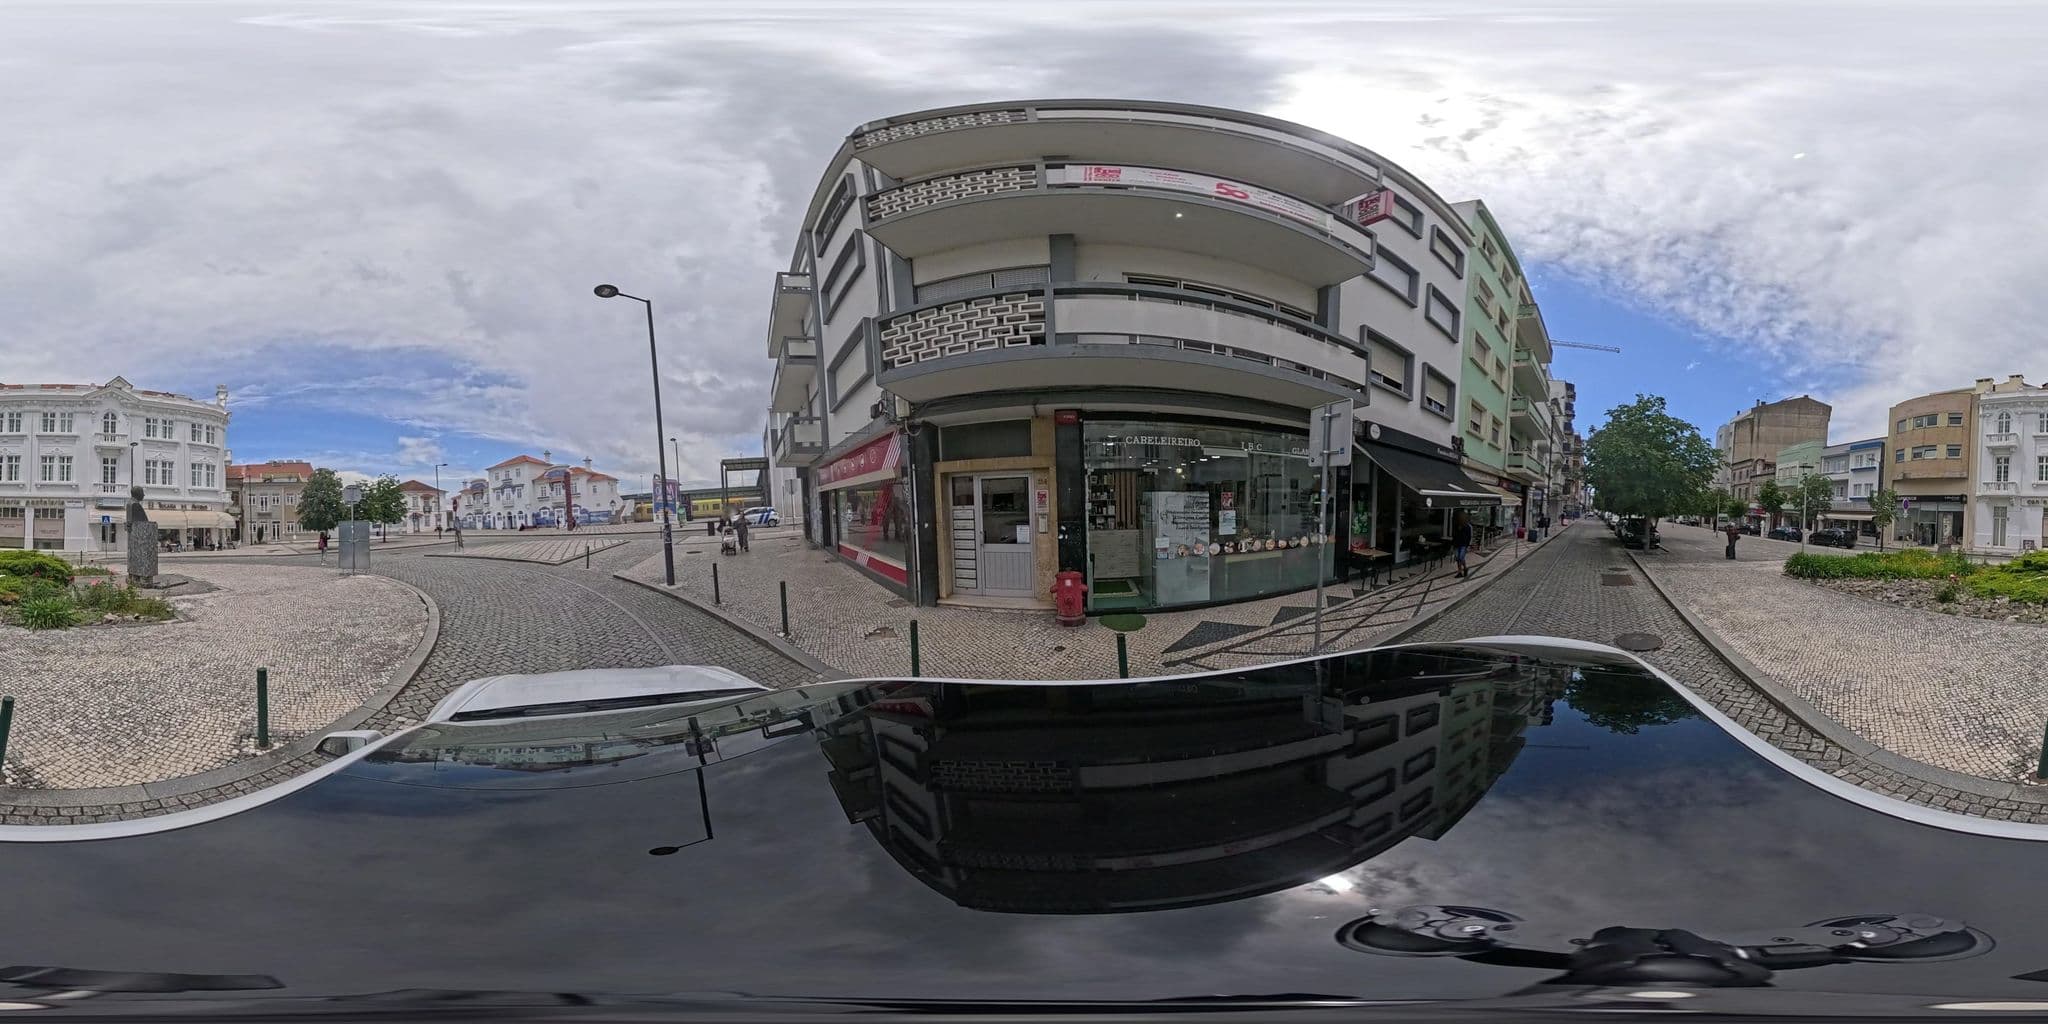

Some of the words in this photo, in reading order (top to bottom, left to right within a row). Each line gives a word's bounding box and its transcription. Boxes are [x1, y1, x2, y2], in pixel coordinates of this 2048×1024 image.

[1214, 182, 1249, 200] 50
[1125, 435, 1201, 447] CABELEIREIRO
[1292, 447, 1309, 456] GLA
